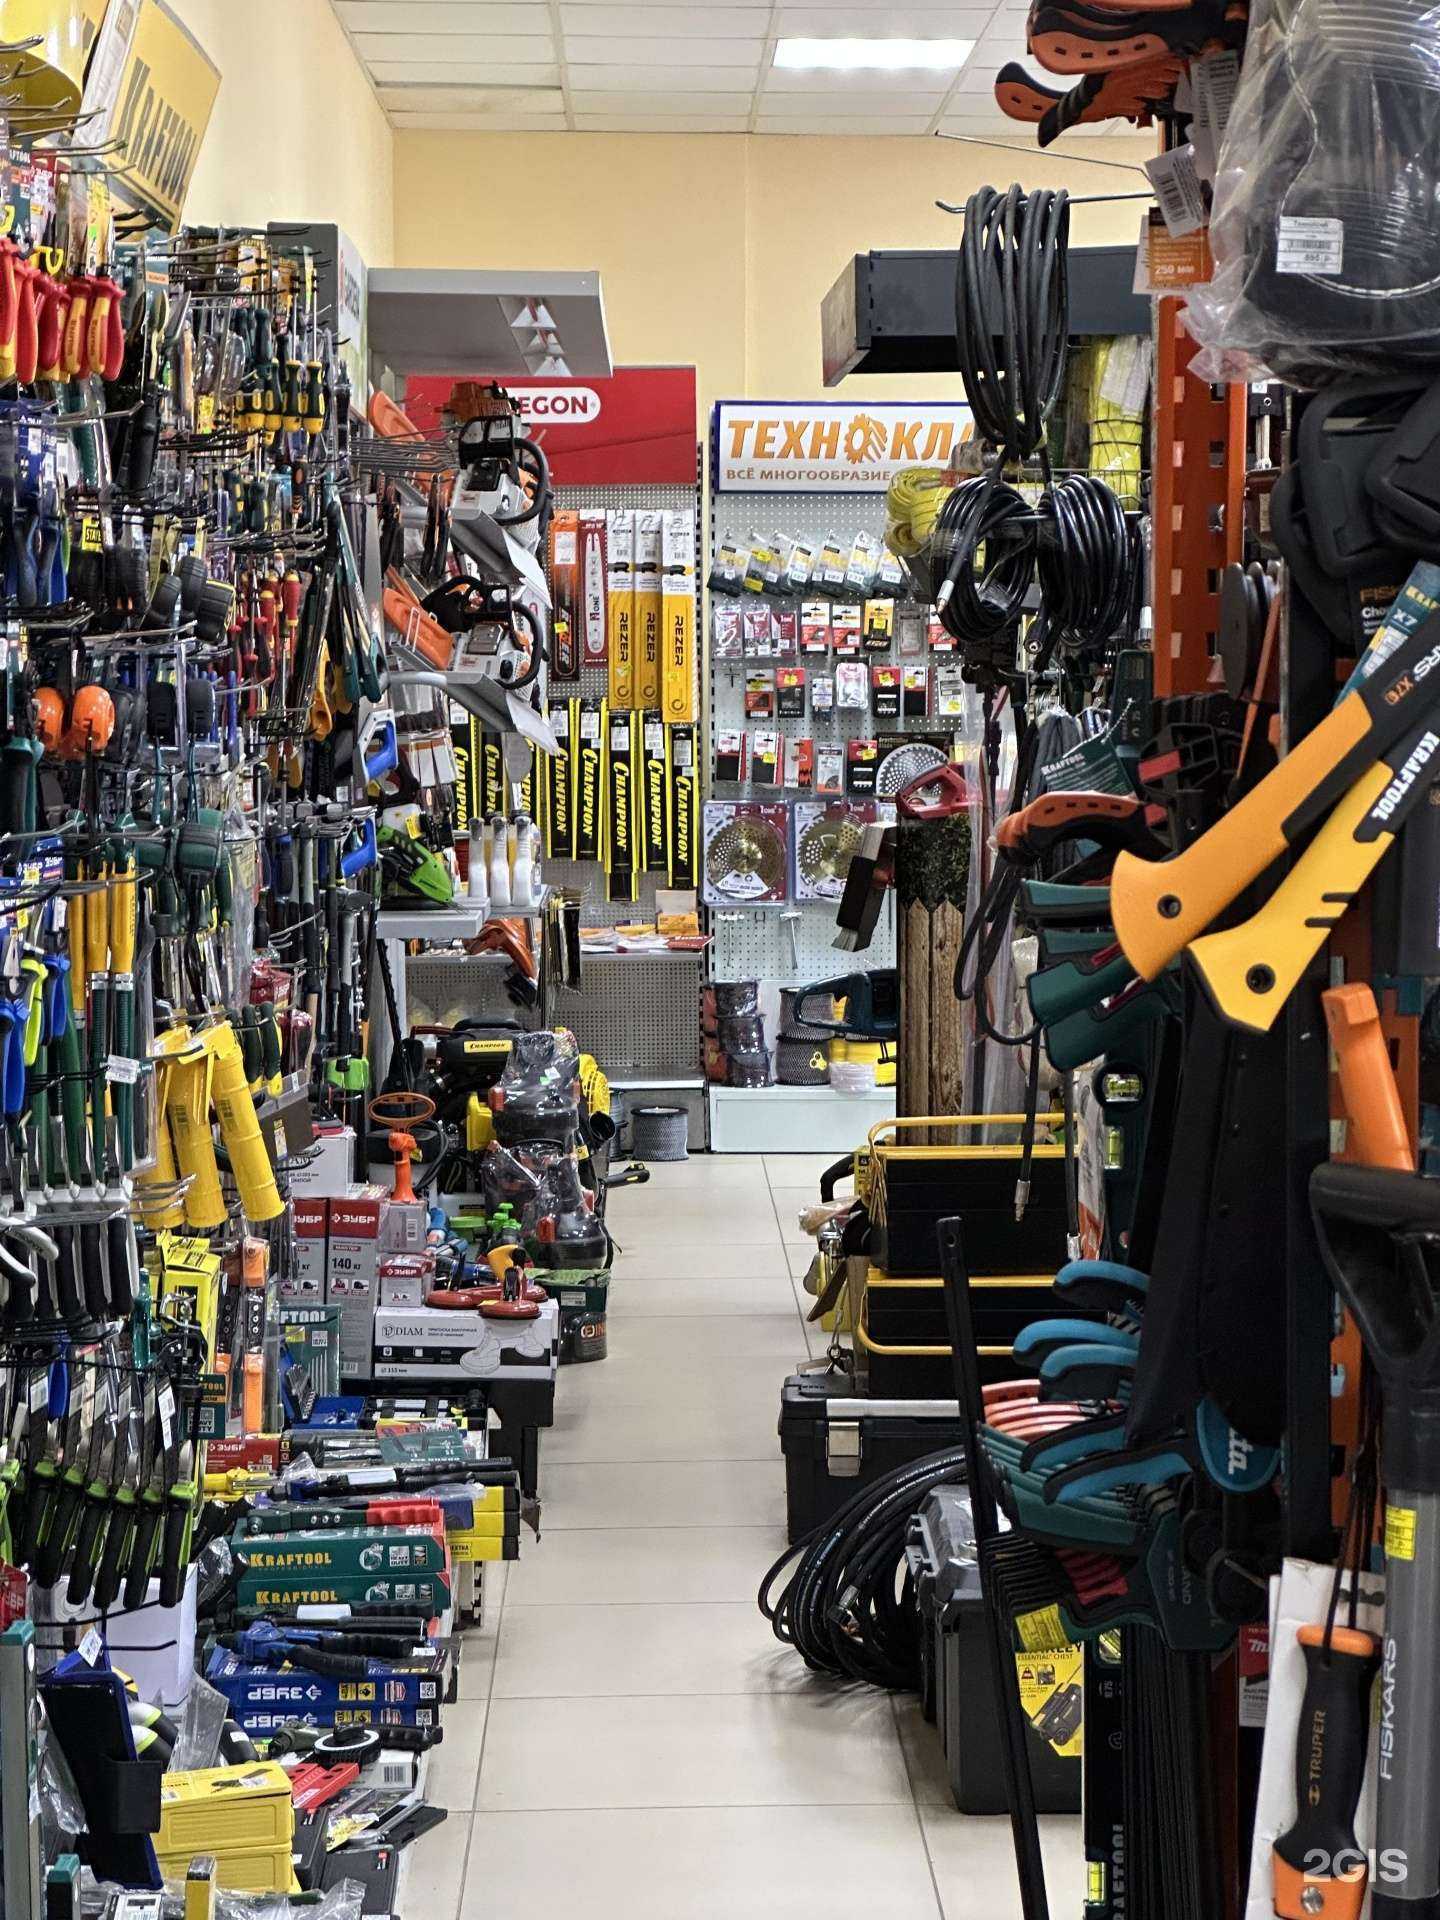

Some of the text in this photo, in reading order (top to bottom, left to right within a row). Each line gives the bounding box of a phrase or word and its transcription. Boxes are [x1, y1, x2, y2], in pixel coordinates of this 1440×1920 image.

[727, 419, 973, 463] ТЕХНОКЛ
[726, 469, 891, 482] ВСЁ МНОГООБРАЗИЕ
[620, 611, 630, 662] REZER
[646, 611, 657, 663] REZER
[673, 615, 684, 667] REZER
[582, 748, 598, 838] CHAMPION
[1371, 731, 1440, 821] KRAFTOOL
[613, 761, 630, 851] CHAMPION
[647, 759, 664, 849] CHAMPION
[675, 775, 692, 865] CHAMPION
[342, 1215, 375, 1224] ЗУБР
[332, 1258, 351, 1270] 140
[395, 1327, 424, 1336] DIAM
[250, 1552, 332, 1568] KRAFTOOL
[256, 1590, 338, 1605] KRAFTOOL
[247, 1684, 303, 1700] ЗУБР
[1379, 1635, 1397, 1780] FISKARS
[1308, 1710, 1327, 1782] TRUPER
